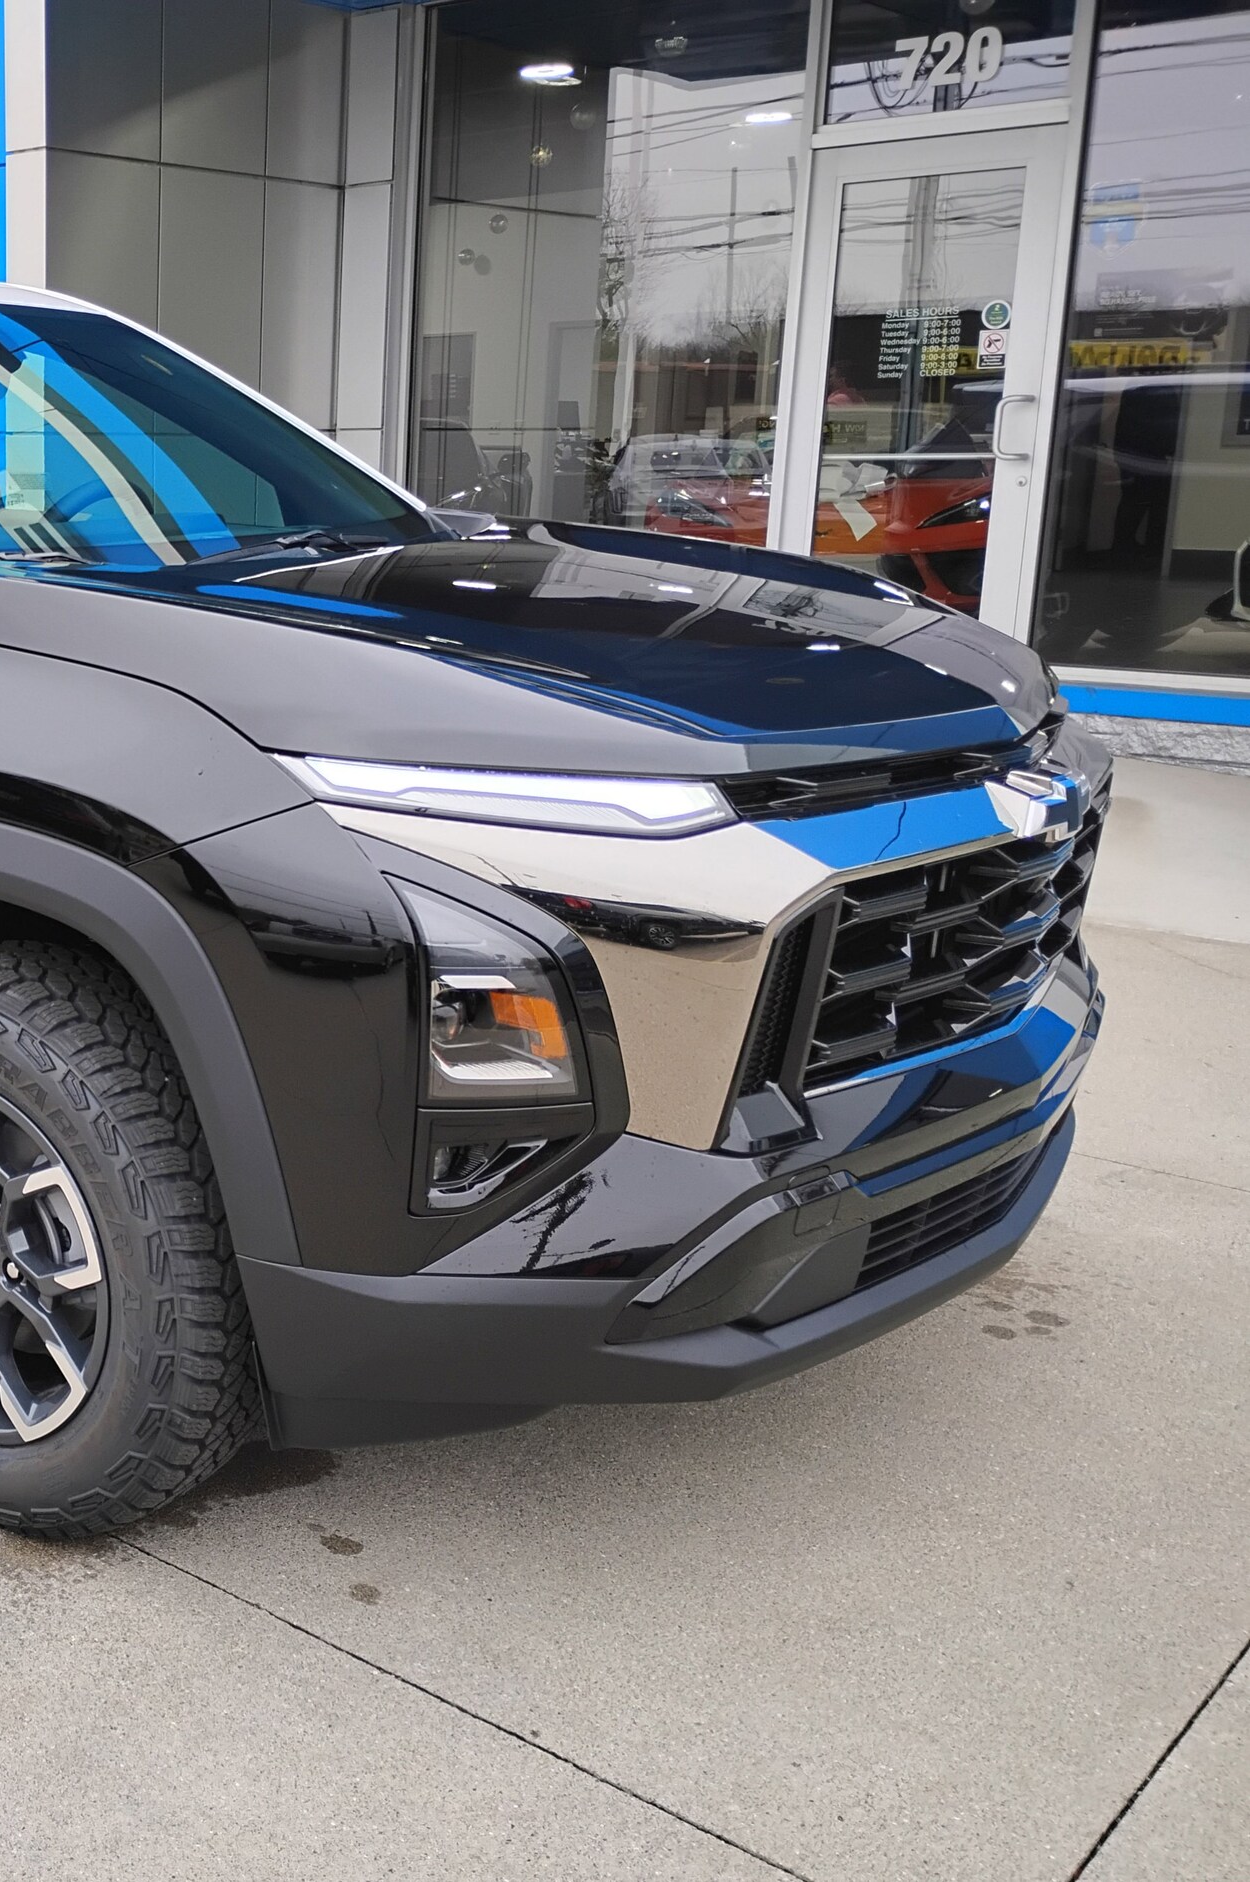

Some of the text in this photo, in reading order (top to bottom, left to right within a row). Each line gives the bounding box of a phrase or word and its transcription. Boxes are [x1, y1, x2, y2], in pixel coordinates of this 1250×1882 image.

[894, 26, 1003, 90] 720
[885, 306, 960, 319] SALES HOURS
[880, 338, 920, 346] Wednesday
[877, 369, 956, 379] Sunday CLOSED
